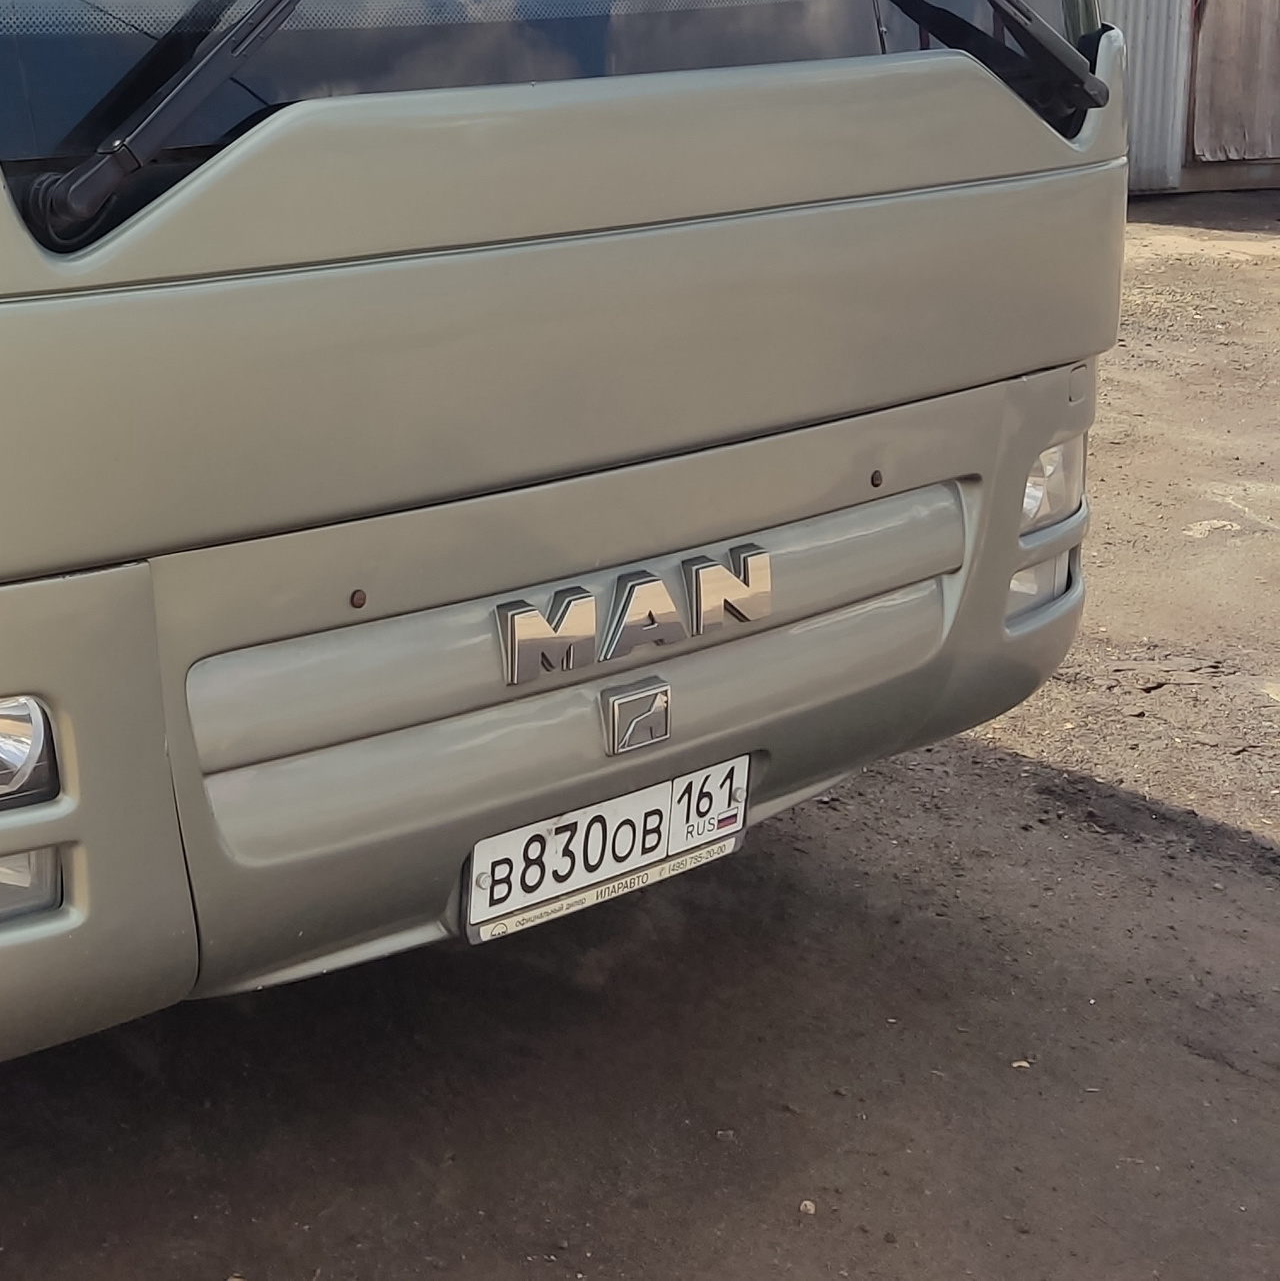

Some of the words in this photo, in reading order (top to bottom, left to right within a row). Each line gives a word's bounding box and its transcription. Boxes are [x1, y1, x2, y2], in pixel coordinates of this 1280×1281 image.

[496, 544, 771, 685] MAN
[677, 766, 735, 824] 161
[686, 817, 716, 841] RUS
[595, 873, 649, 901] ИЛАРАВТО
